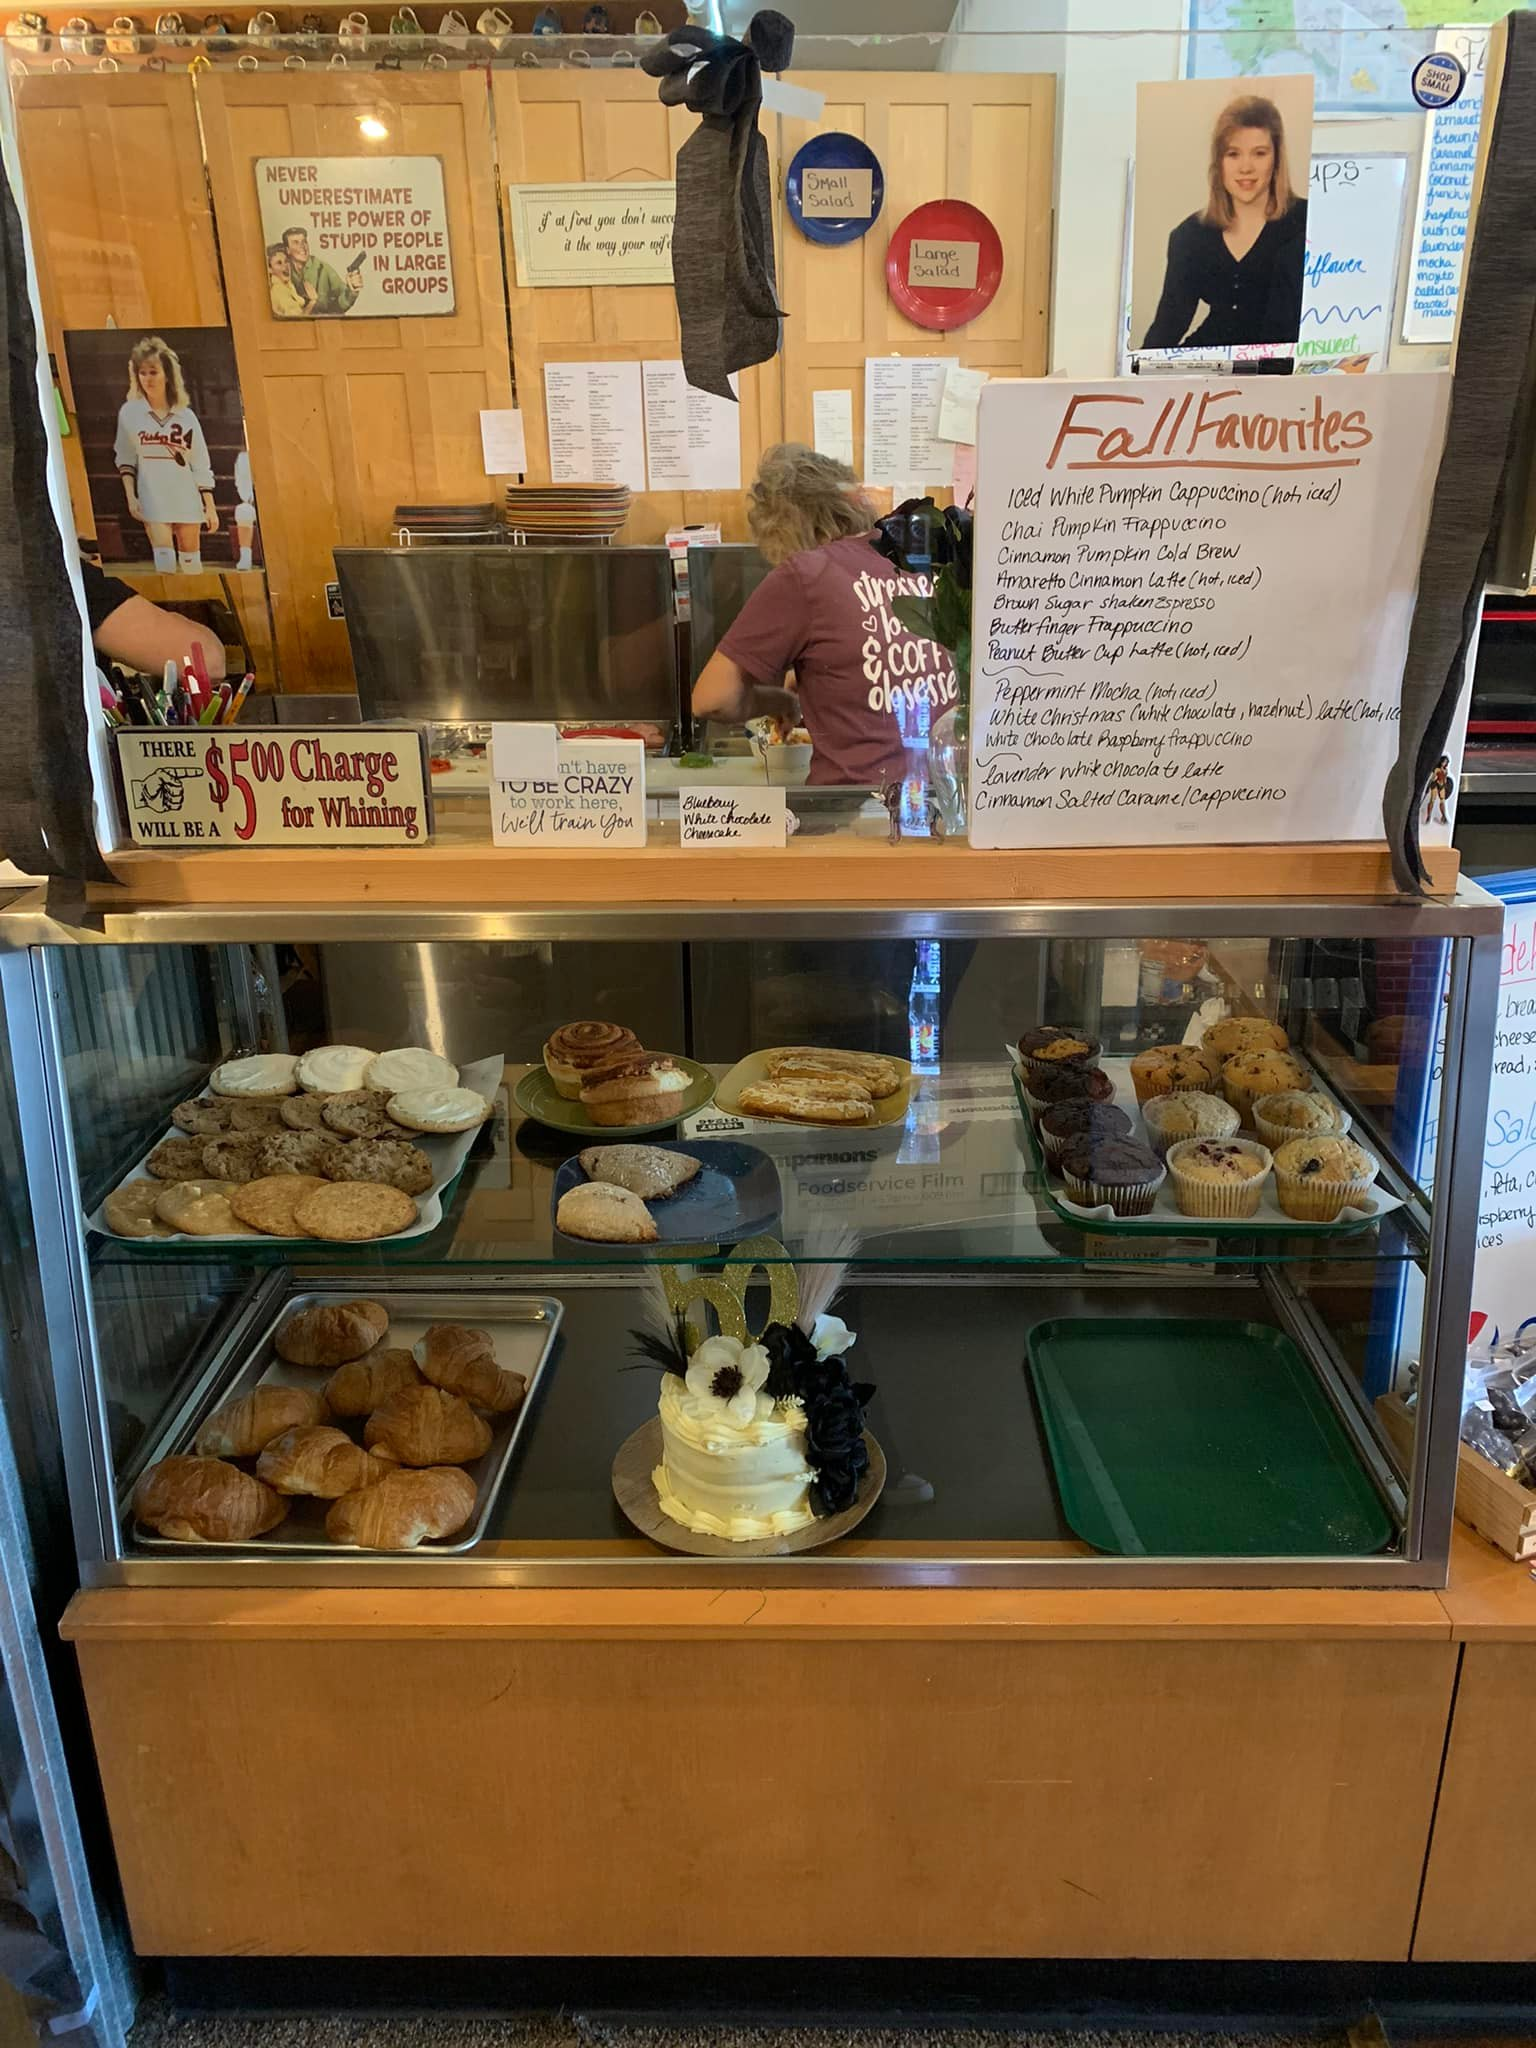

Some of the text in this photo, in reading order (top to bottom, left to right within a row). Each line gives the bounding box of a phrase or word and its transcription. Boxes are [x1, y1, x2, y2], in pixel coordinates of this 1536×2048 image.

[1421, 77, 1451, 93] SMALL
[1425, 69, 1453, 82] SHOP
[265, 165, 318, 183] NEVER
[278, 188, 413, 206] UNDERESTIMATE
[310, 209, 432, 228] THE POWER OF
[538, 210, 552, 233] if
[555, 215, 565, 226] at
[564, 209, 593, 233] first
[594, 216, 616, 232] you
[621, 206, 647, 225] don't
[319, 231, 444, 250] STUPID PEOPLE
[564, 239, 572, 252] it
[576, 235, 592, 252] the
[596, 241, 617, 257] way
[618, 241, 646, 257] your
[373, 254, 447, 272] IN LARGE
[915, 243, 959, 267] Large
[1418, 257, 1456, 268] mocha
[382, 276, 449, 294] GROUPS
[171, 423, 193, 450] 24
[1046, 392, 1193, 470] Fall
[1186, 388, 1373, 454] Favorites
[1008, 483, 1045, 509] Iced
[1050, 480, 1094, 507] White
[1099, 482, 1162, 513] Pumpkin
[1168, 480, 1260, 513] Cappuccino
[1305, 477, 1342, 506] iced)
[1001, 514, 1227, 544] Chai Pumpkin Frappuccino
[997, 543, 1241, 567] Cinnamon Pumpkin Cold Brew
[996, 570, 1066, 591] Amaretto
[1069, 570, 1144, 591] Cinnamon
[1188, 566, 1225, 590] (hot,
[992, 593, 1039, 611] Brown
[1047, 594, 1094, 618] Sugar
[1088, 615, 1193, 640] Frappuccino
[988, 639, 1036, 662] Peanut
[1042, 643, 1091, 663] Butter
[1093, 642, 1124, 665] Cup
[1175, 640, 1211, 660] (hot,
[1213, 634, 1253, 660] iced)
[995, 678, 1087, 706] Peppermint
[1090, 681, 1142, 701] Mocha
[989, 707, 1039, 726] White
[1040, 707, 1123, 727] Christmas
[1248, 693, 1313, 720] hazelnut)
[1351, 698, 1385, 723] (hot,
[139, 740, 196, 758] THERE
[1097, 727, 1166, 759] Raspberry
[289, 737, 399, 798] Charge
[585, 759, 627, 775] have
[532, 780, 559, 794] BE
[563, 775, 634, 795] CRAZY
[510, 794, 624, 811] to work here,
[682, 796, 738, 815] Blueberry
[975, 790, 1053, 811] Cinnamon
[1055, 789, 1116, 811] Salted
[1188, 786, 1287, 812] Cappuccino
[137, 820, 222, 839] WILL BE A
[281, 796, 418, 840] for Whining
[500, 809, 546, 834] We'll
[549, 812, 597, 831] train
[683, 812, 718, 826] White
[683, 826, 742, 840] Cheesecake
[797, 1175, 916, 1197] Foodservice
[921, 1172, 964, 1189] Film
